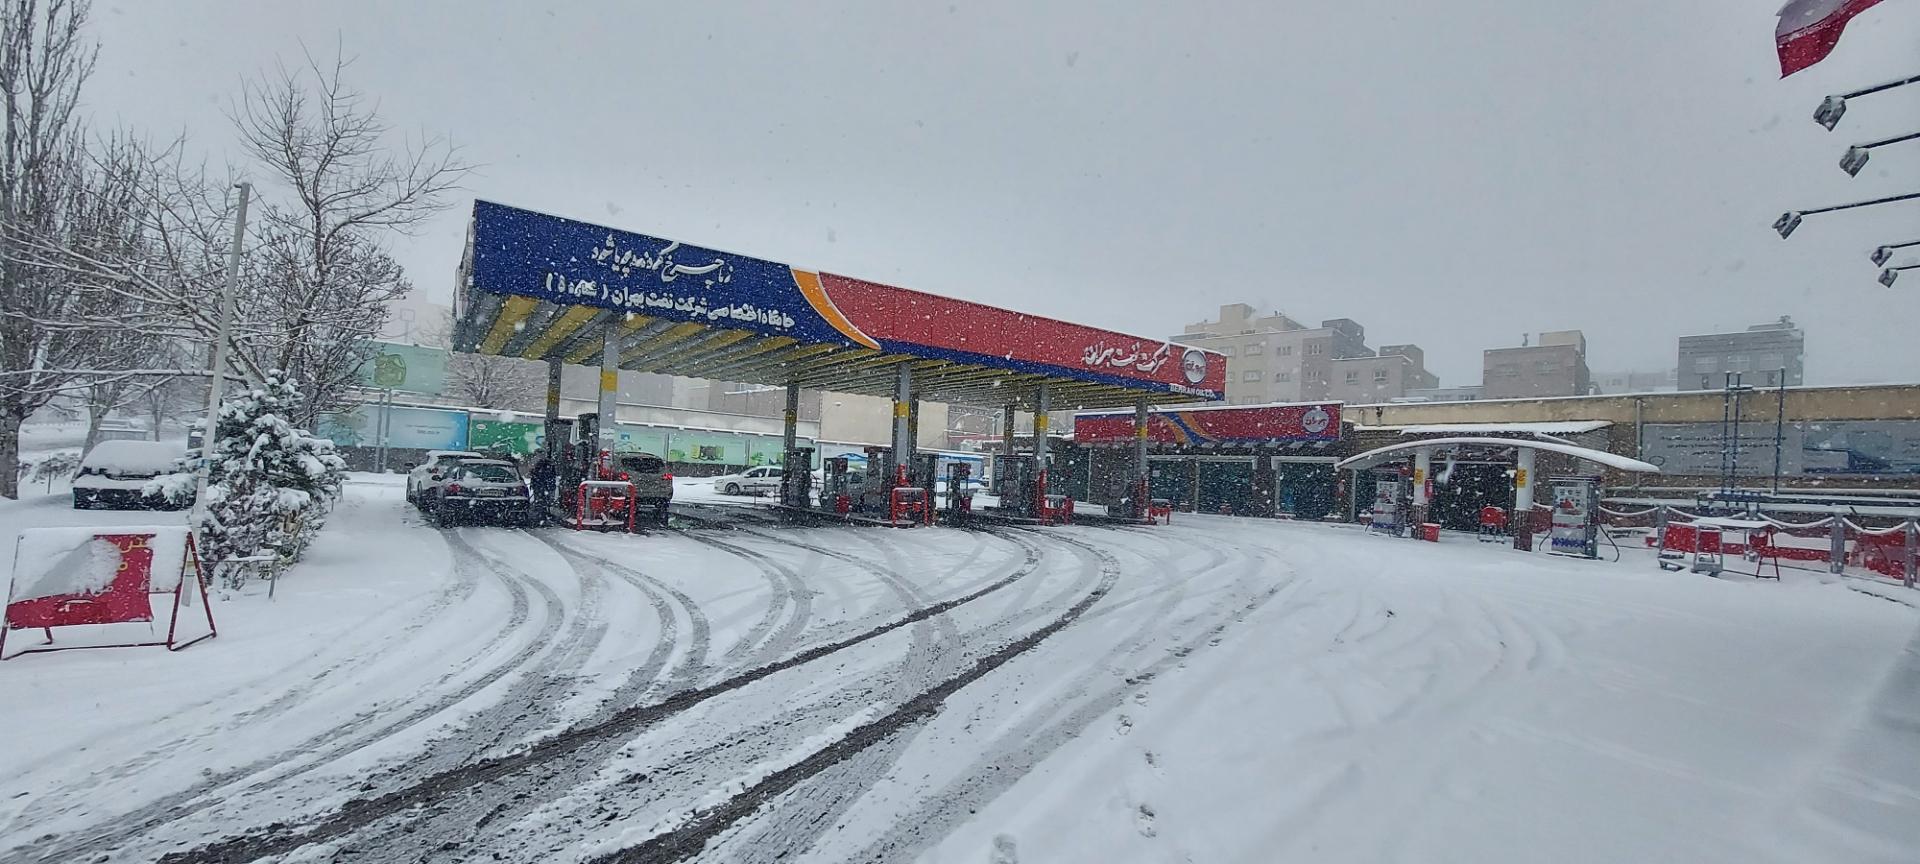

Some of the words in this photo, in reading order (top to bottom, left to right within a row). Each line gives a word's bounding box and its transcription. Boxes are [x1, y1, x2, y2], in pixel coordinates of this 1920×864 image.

[611, 286, 645, 309] بهران
[645, 291, 674, 309] نفت
[675, 296, 708, 319] شرکت
[707, 302, 762, 324] اختصاصی
[762, 308, 796, 332] جایگاه
[1111, 341, 1141, 367] نفت
